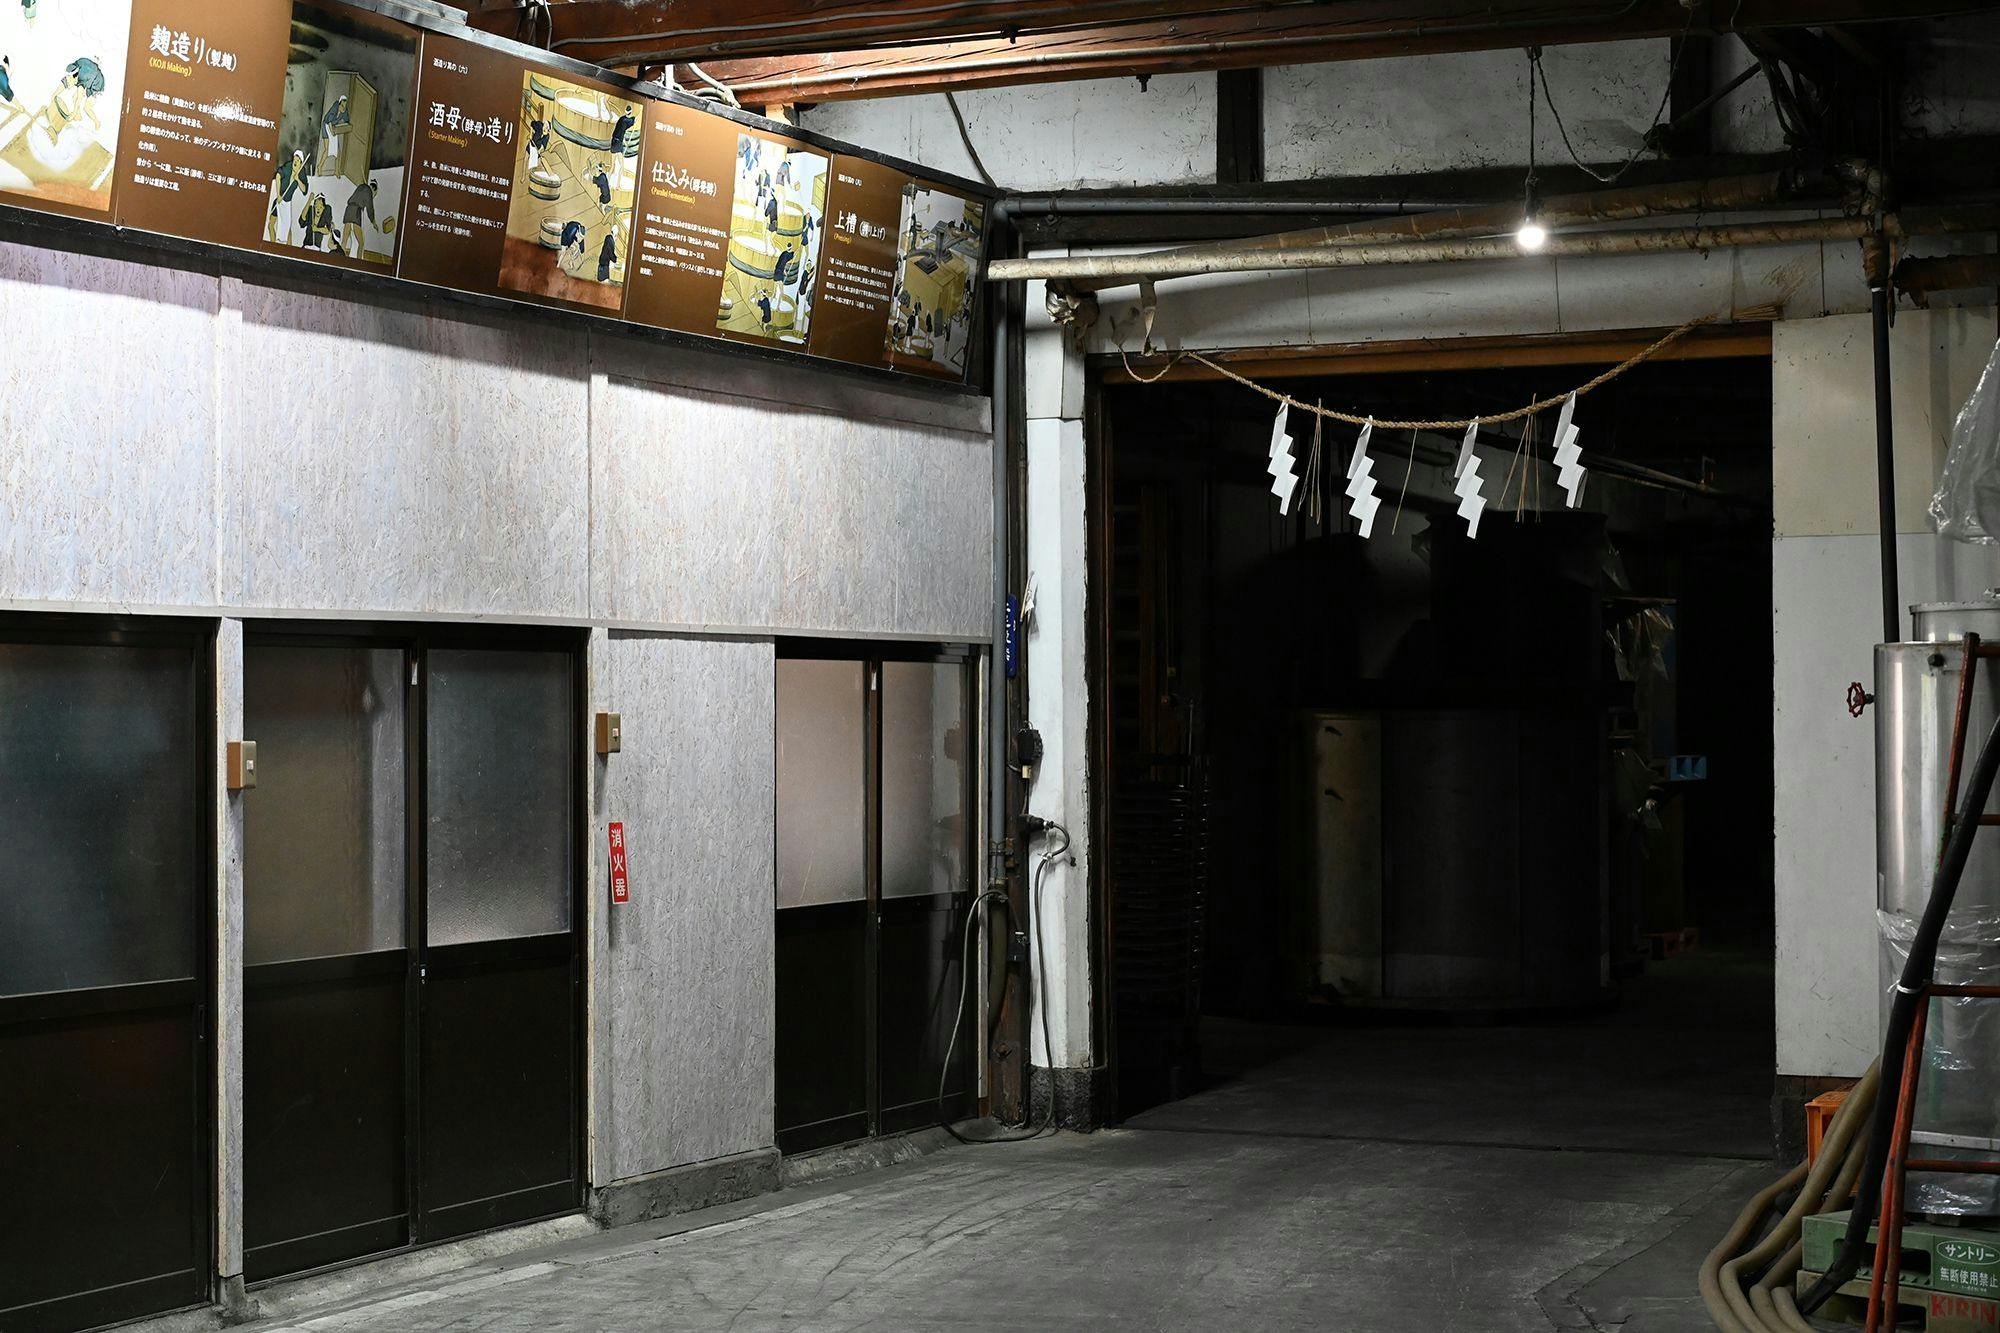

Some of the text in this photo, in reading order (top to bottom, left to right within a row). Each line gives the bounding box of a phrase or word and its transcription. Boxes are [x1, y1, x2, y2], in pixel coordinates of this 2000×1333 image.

[611, 828, 626, 897] 消火器
[1945, 1244, 1995, 1261] サントリー
[1940, 1266, 1999, 1288] 無断使用禁止
[1931, 1295, 1997, 1325] KIRIN
